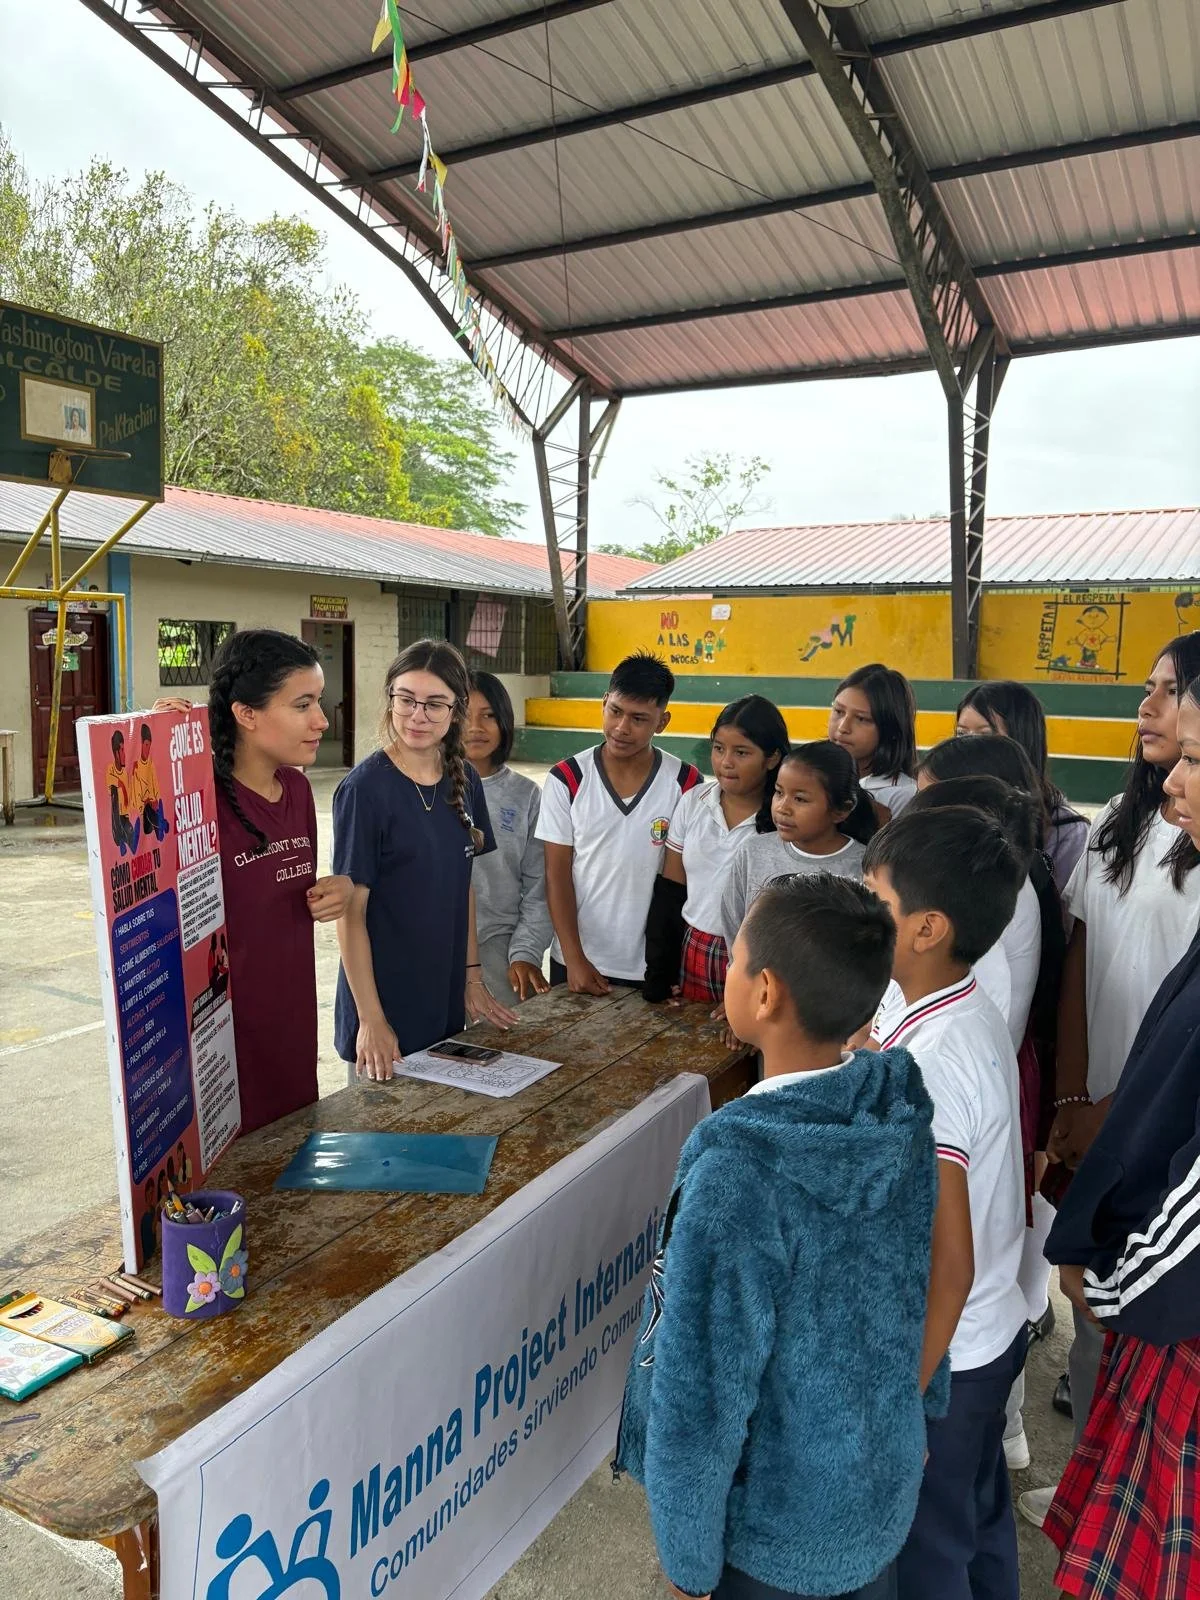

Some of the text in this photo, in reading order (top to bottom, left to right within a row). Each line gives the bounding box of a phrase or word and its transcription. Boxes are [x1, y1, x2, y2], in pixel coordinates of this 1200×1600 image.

[96, 335, 157, 378] Varela
[661, 611, 679, 630] NO
[669, 632, 690, 647] LAS
[191, 720, 204, 754] ES
[172, 761, 184, 796] LA
[175, 791, 203, 833] SALUD
[152, 848, 161, 870] TU
[177, 820, 217, 870] MENTAL?
[276, 862, 312, 882] COLLEGE
[113, 871, 158, 914] SALUD MENTAL
[117, 922, 132, 936] HABLA
[131, 913, 146, 927] SOBRE
[121, 958, 134, 973] COME
[133, 943, 156, 964] ALIMENTOS
[350, 1206, 665, 1559] Manna Project Internati
[371, 1428, 517, 1597] Comunidades
[524, 1346, 597, 1440] sirviendo
